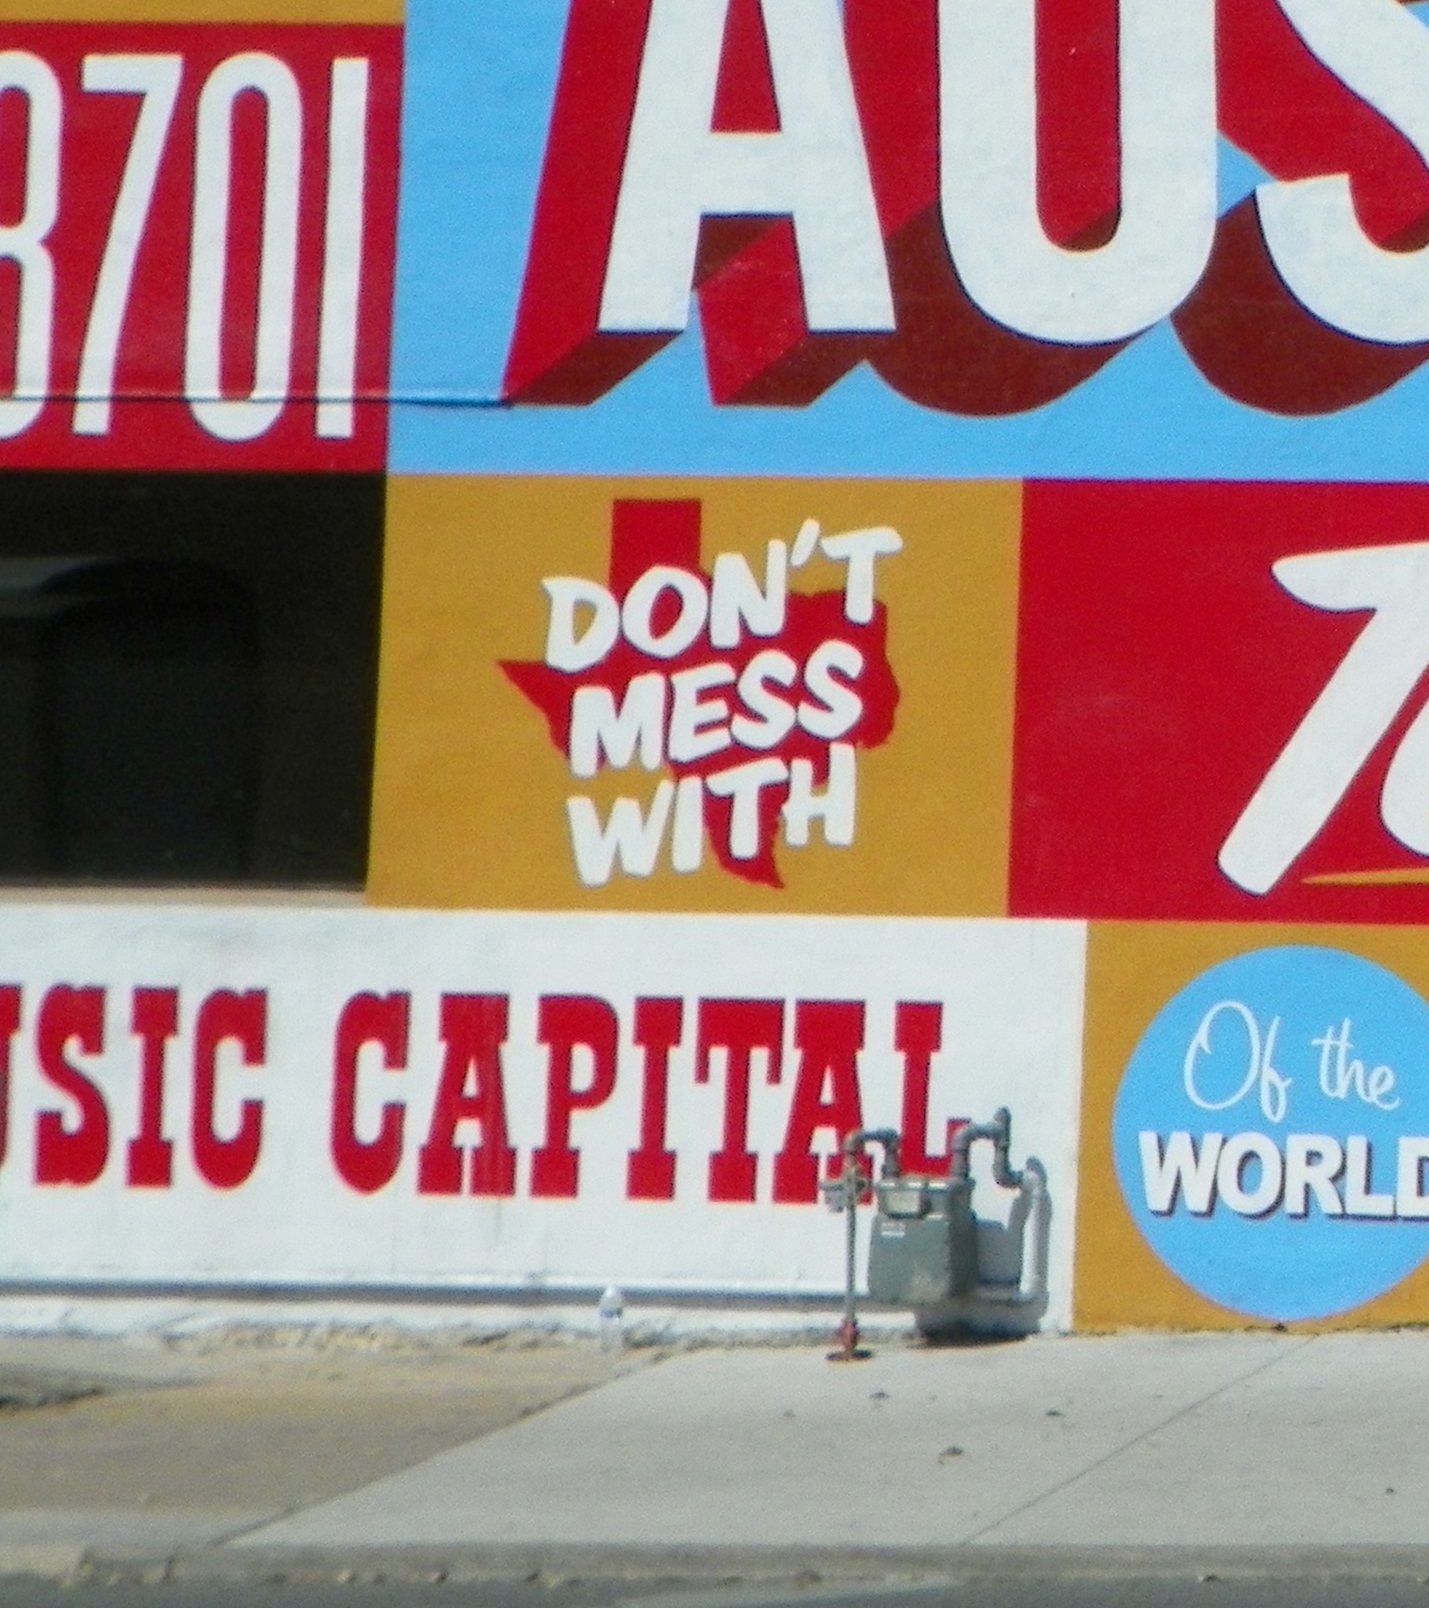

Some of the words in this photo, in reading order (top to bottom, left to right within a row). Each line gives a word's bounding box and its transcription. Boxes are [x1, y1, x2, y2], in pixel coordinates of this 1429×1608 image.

[540, 517, 904, 674] DON'T
[567, 639, 865, 780] MESS
[565, 742, 857, 889] WITH
[0, 983, 269, 1191] SIC
[329, 988, 973, 1205] CAPITAL
[1183, 1000, 1292, 1124] Of
[1311, 1017, 1401, 1111] the
